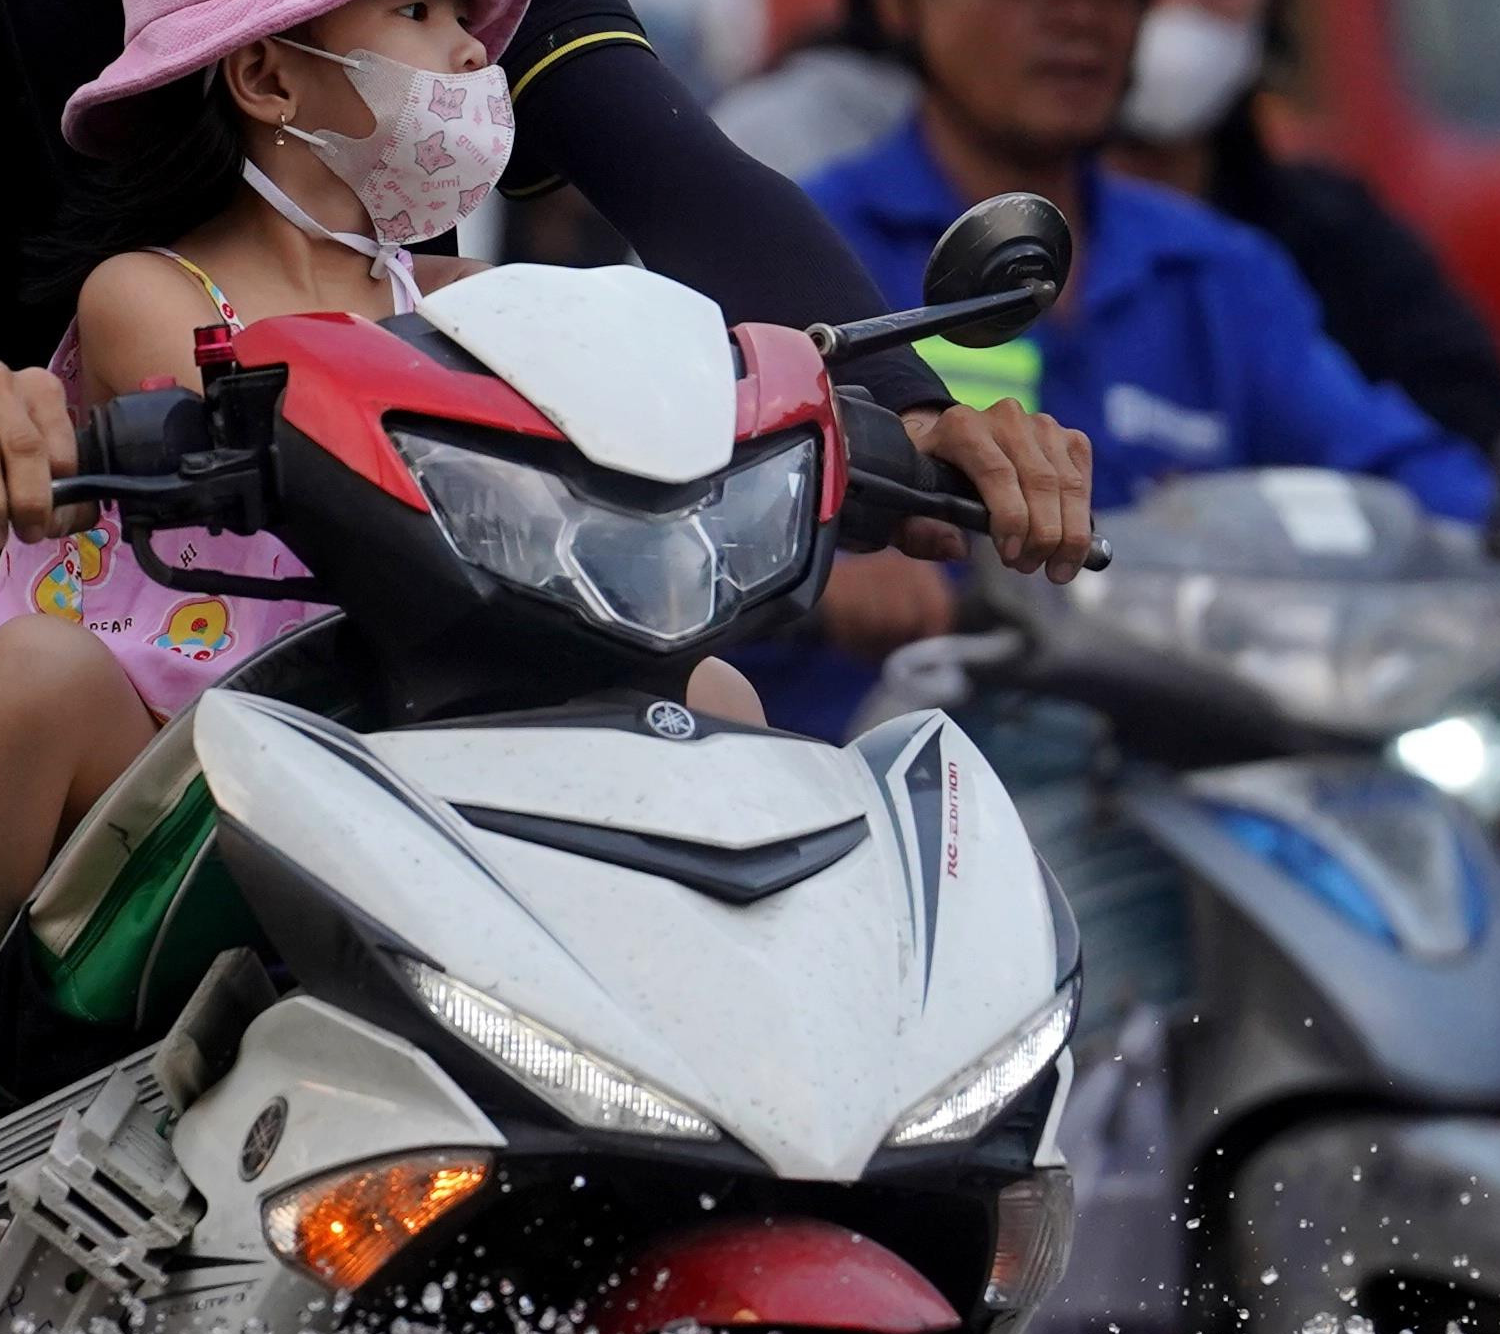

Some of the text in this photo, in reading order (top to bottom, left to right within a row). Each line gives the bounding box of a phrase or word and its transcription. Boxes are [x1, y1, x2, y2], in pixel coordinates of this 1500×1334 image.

[456, 134, 489, 166] gumi
[421, 175, 461, 193] gumi
[180, 542, 198, 568] HI
